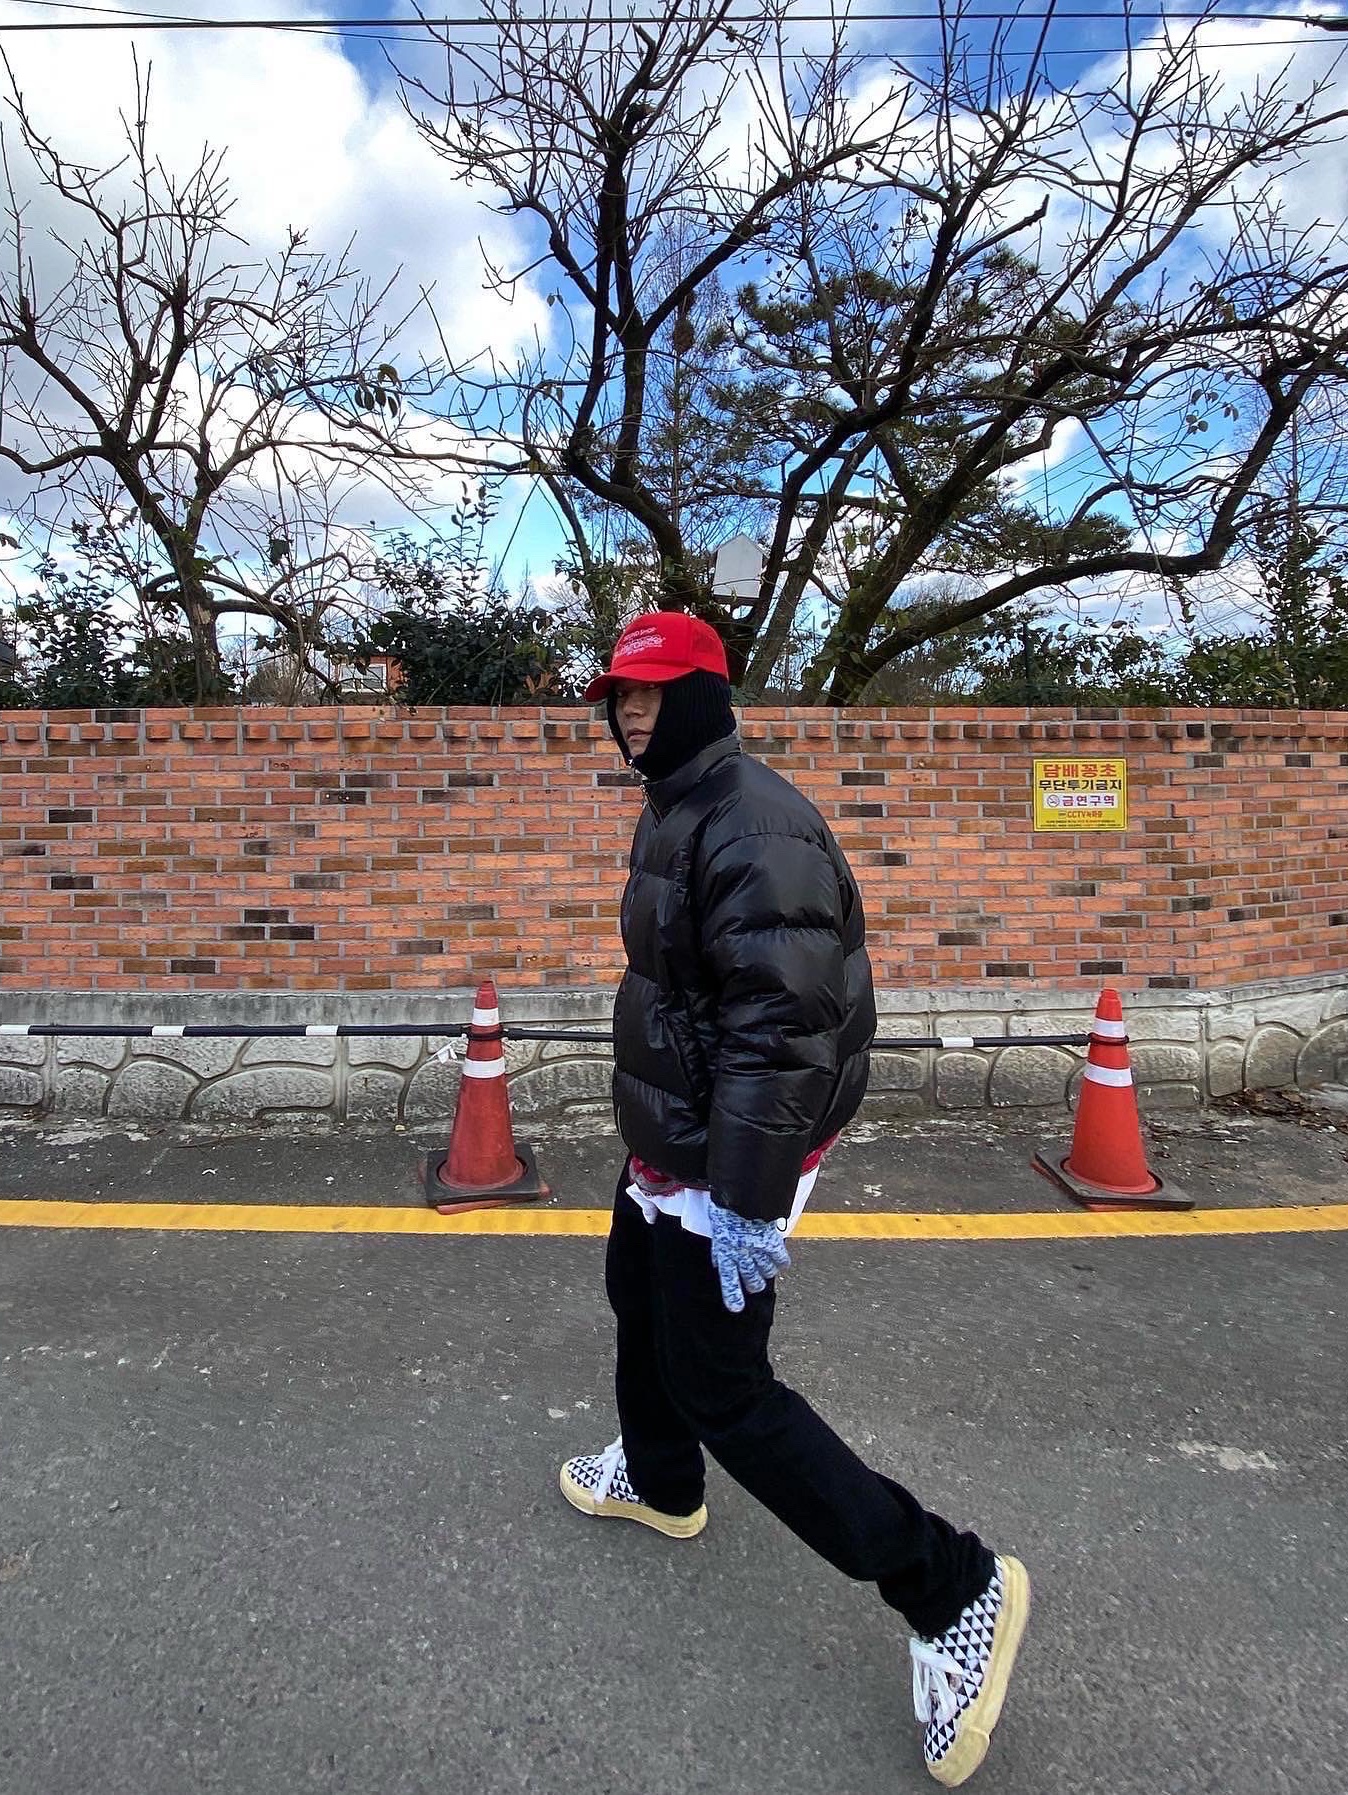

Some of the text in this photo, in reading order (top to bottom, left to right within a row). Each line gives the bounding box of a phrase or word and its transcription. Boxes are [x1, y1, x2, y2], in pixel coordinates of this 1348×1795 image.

[1043, 764, 1117, 778] 담배꽁초
[1038, 779, 1122, 791] 무단투기금지
[1062, 795, 1115, 807] 금연구역
